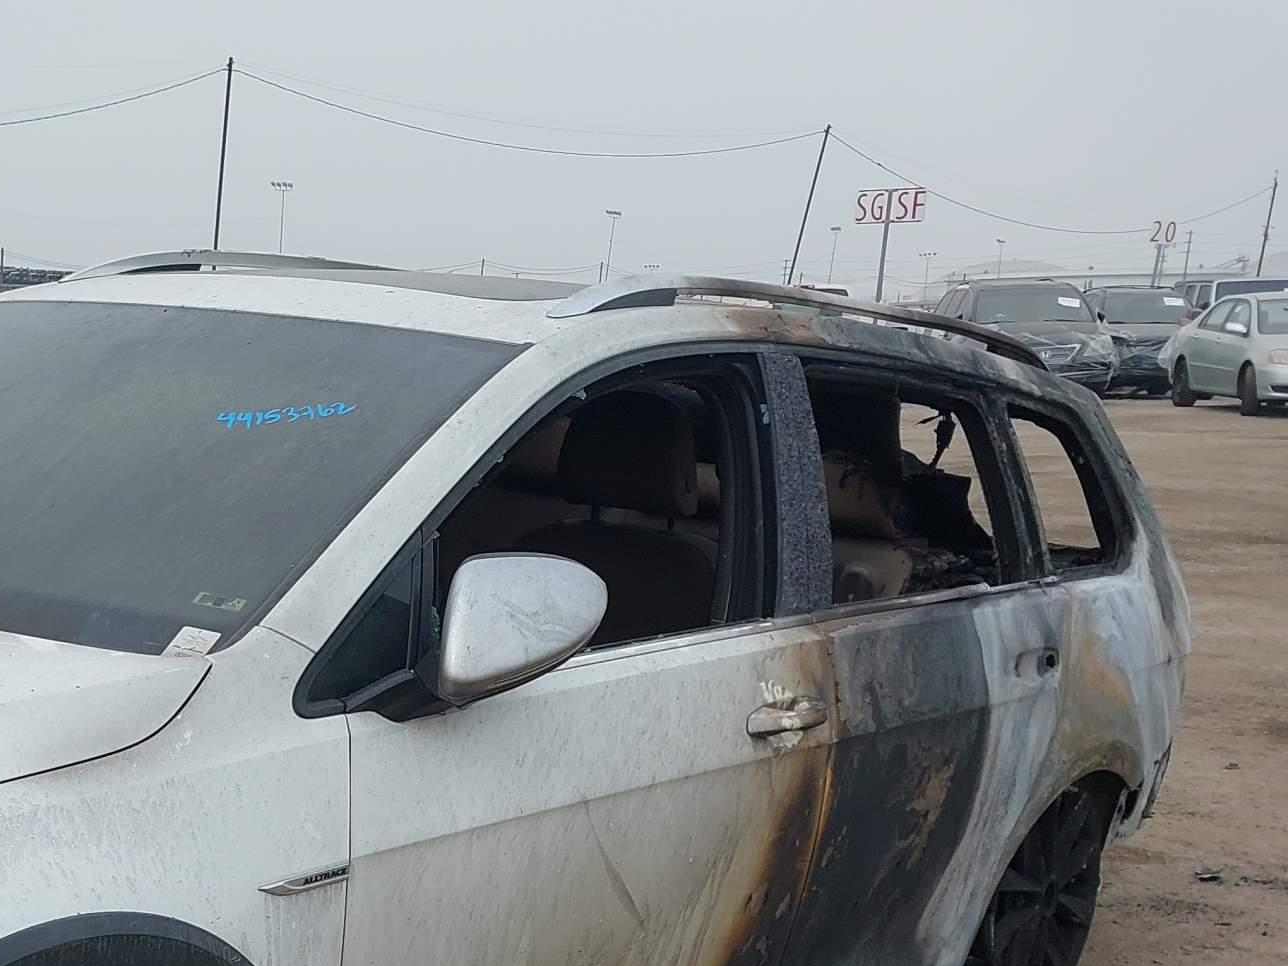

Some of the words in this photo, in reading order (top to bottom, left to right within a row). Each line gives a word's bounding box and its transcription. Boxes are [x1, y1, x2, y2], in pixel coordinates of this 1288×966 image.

[855, 193, 884, 221] SG
[895, 191, 926, 219] SF
[1150, 221, 1176, 242] 20
[216, 402, 358, 429] 44153762
[303, 868, 347, 886] ALLTRACK
